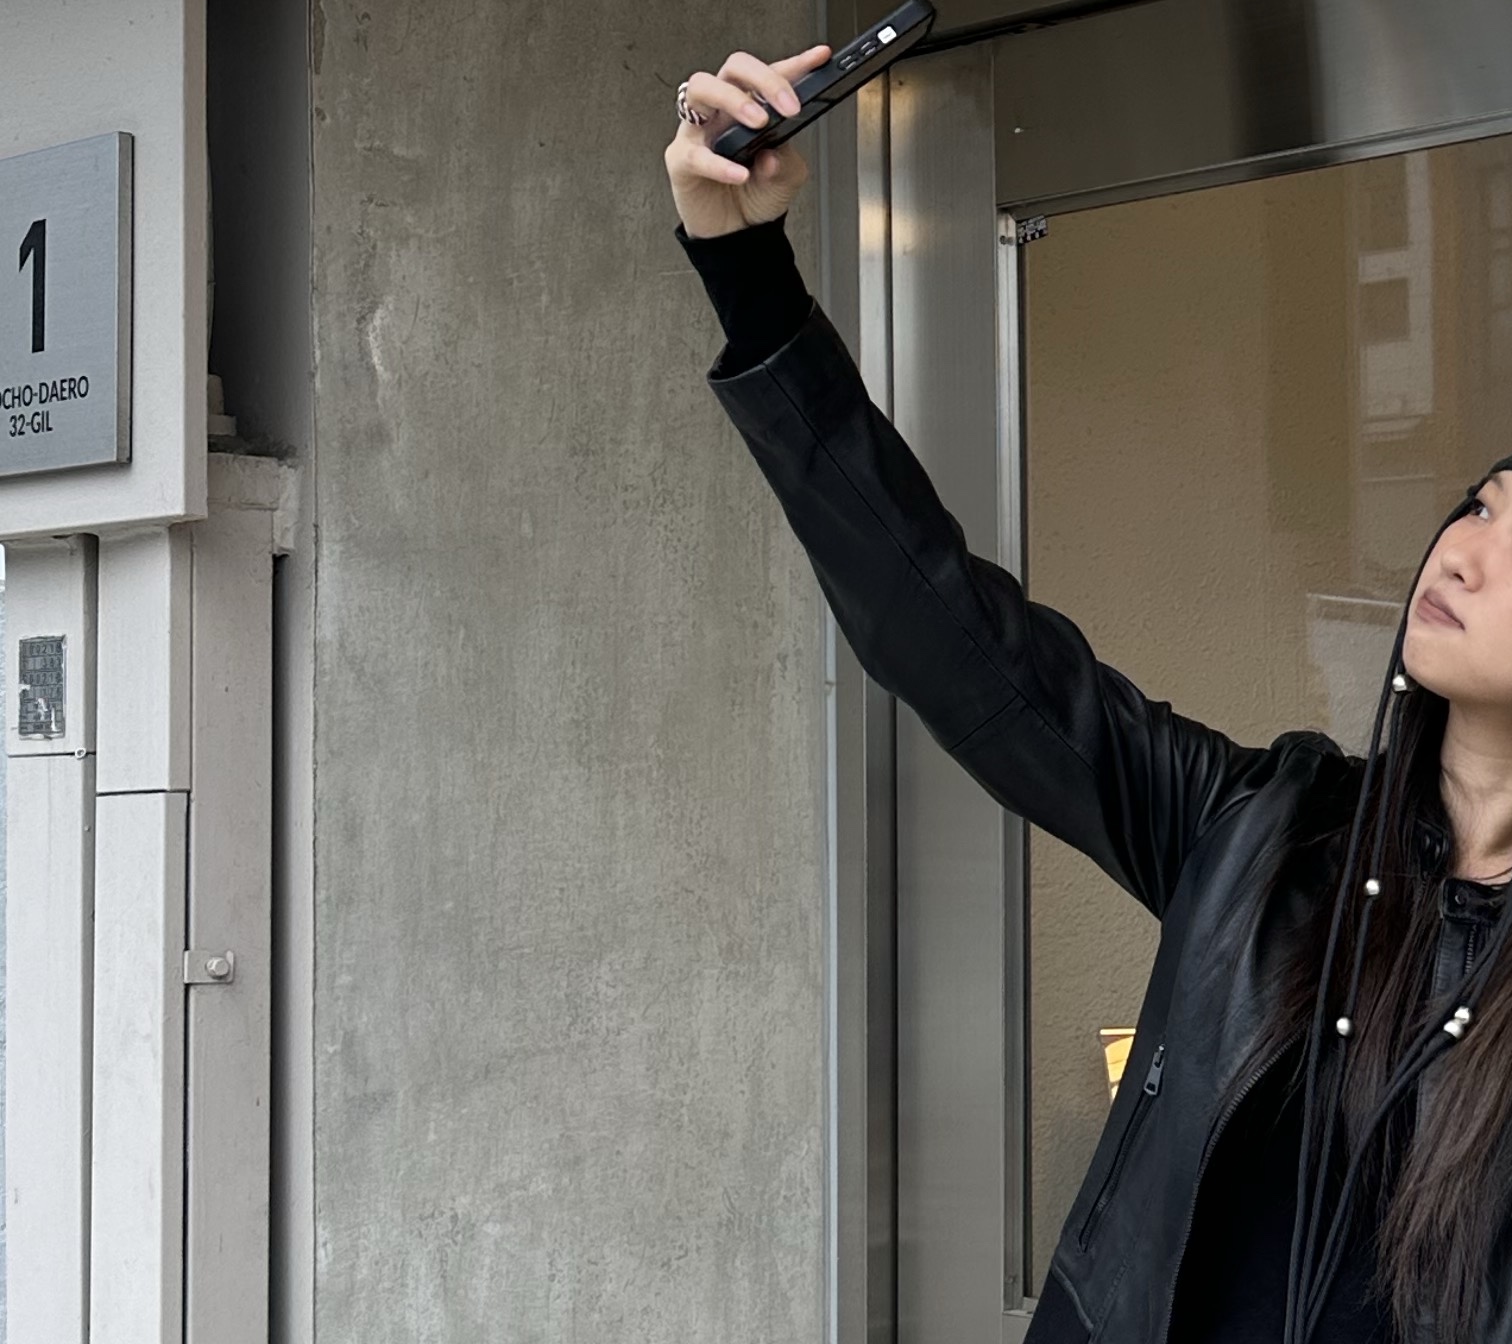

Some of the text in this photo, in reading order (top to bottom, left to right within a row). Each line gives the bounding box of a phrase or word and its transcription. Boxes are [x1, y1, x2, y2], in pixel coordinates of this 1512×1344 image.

[18, 218, 47, 354] 1
[0, 375, 89, 410] CHO-DAERO
[9, 410, 53, 438] 32-GIL
